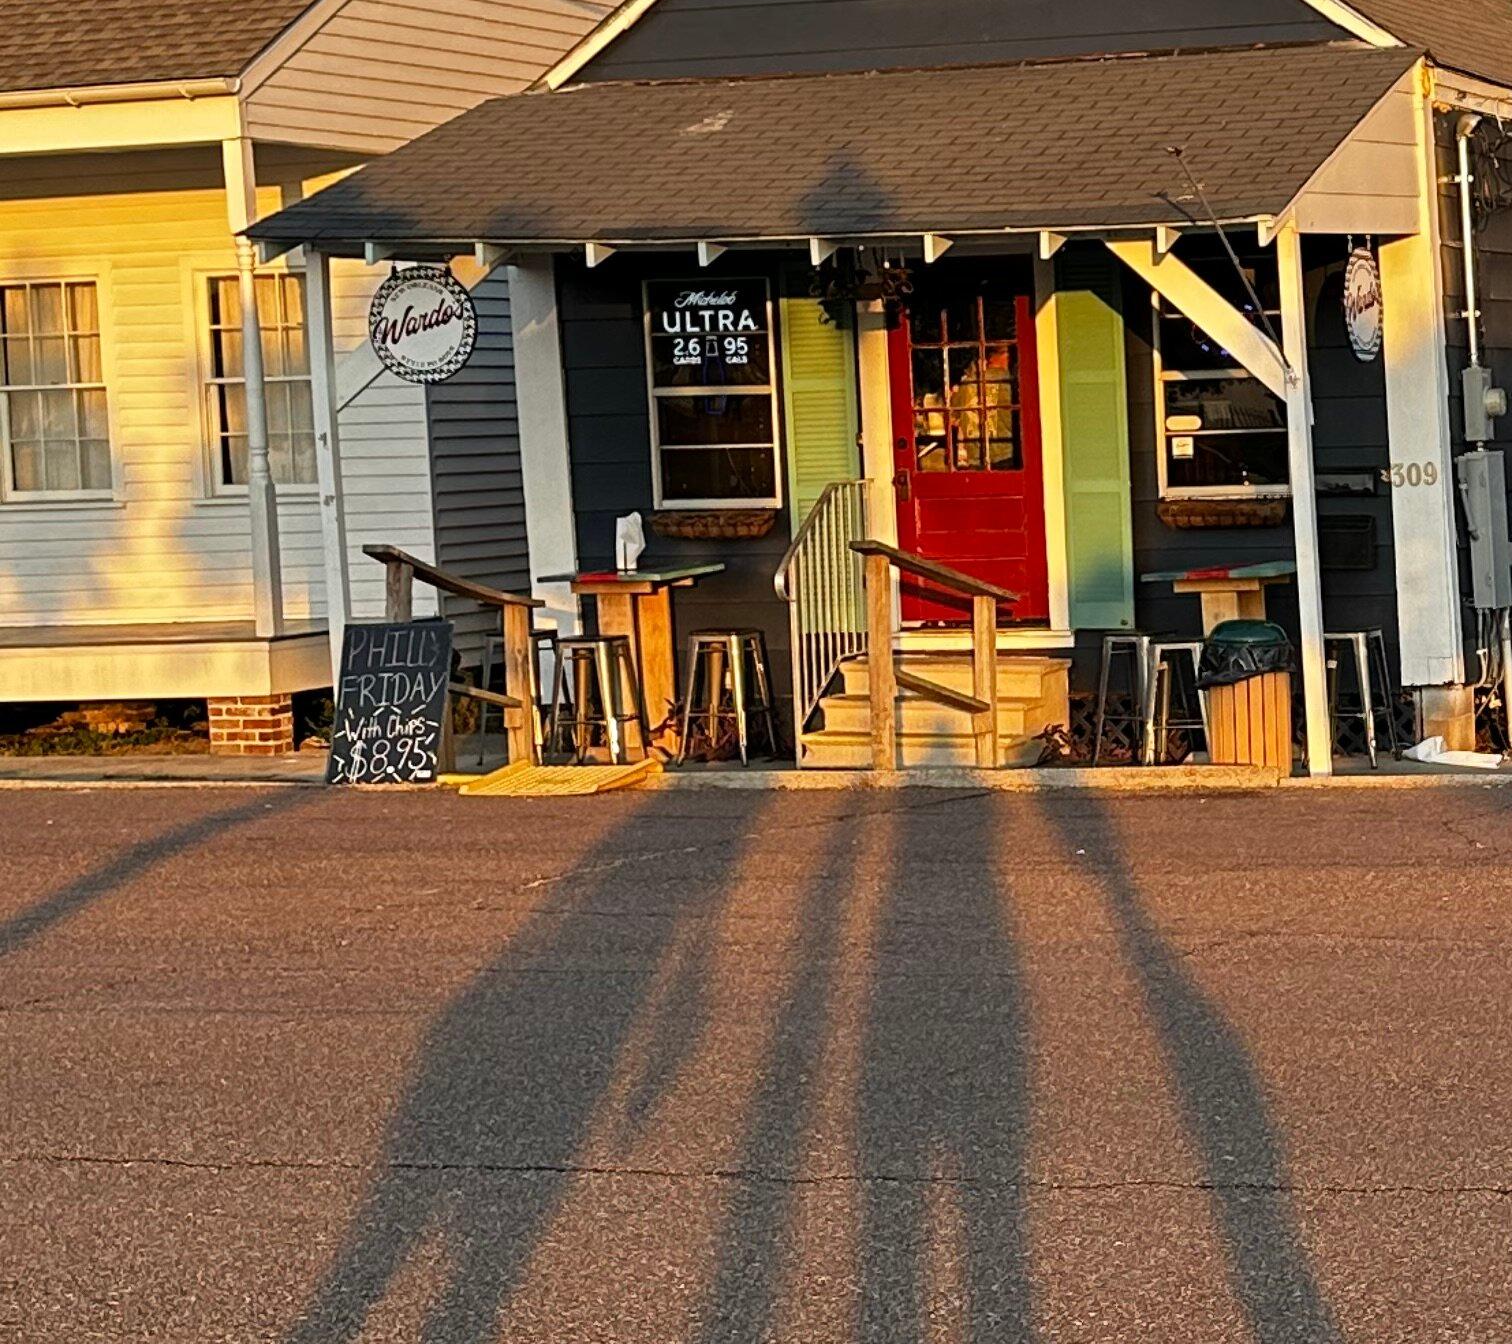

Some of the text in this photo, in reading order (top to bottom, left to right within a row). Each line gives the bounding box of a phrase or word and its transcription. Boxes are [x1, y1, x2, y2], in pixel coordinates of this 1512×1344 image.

[662, 309, 758, 333] ULTRA
[673, 337, 748, 355] 2.6 95
[1390, 461, 1438, 488] 309
[339, 671, 447, 710] FRIDAY
[344, 715, 426, 742] With Chips
[344, 736, 427, 784] $8.95
